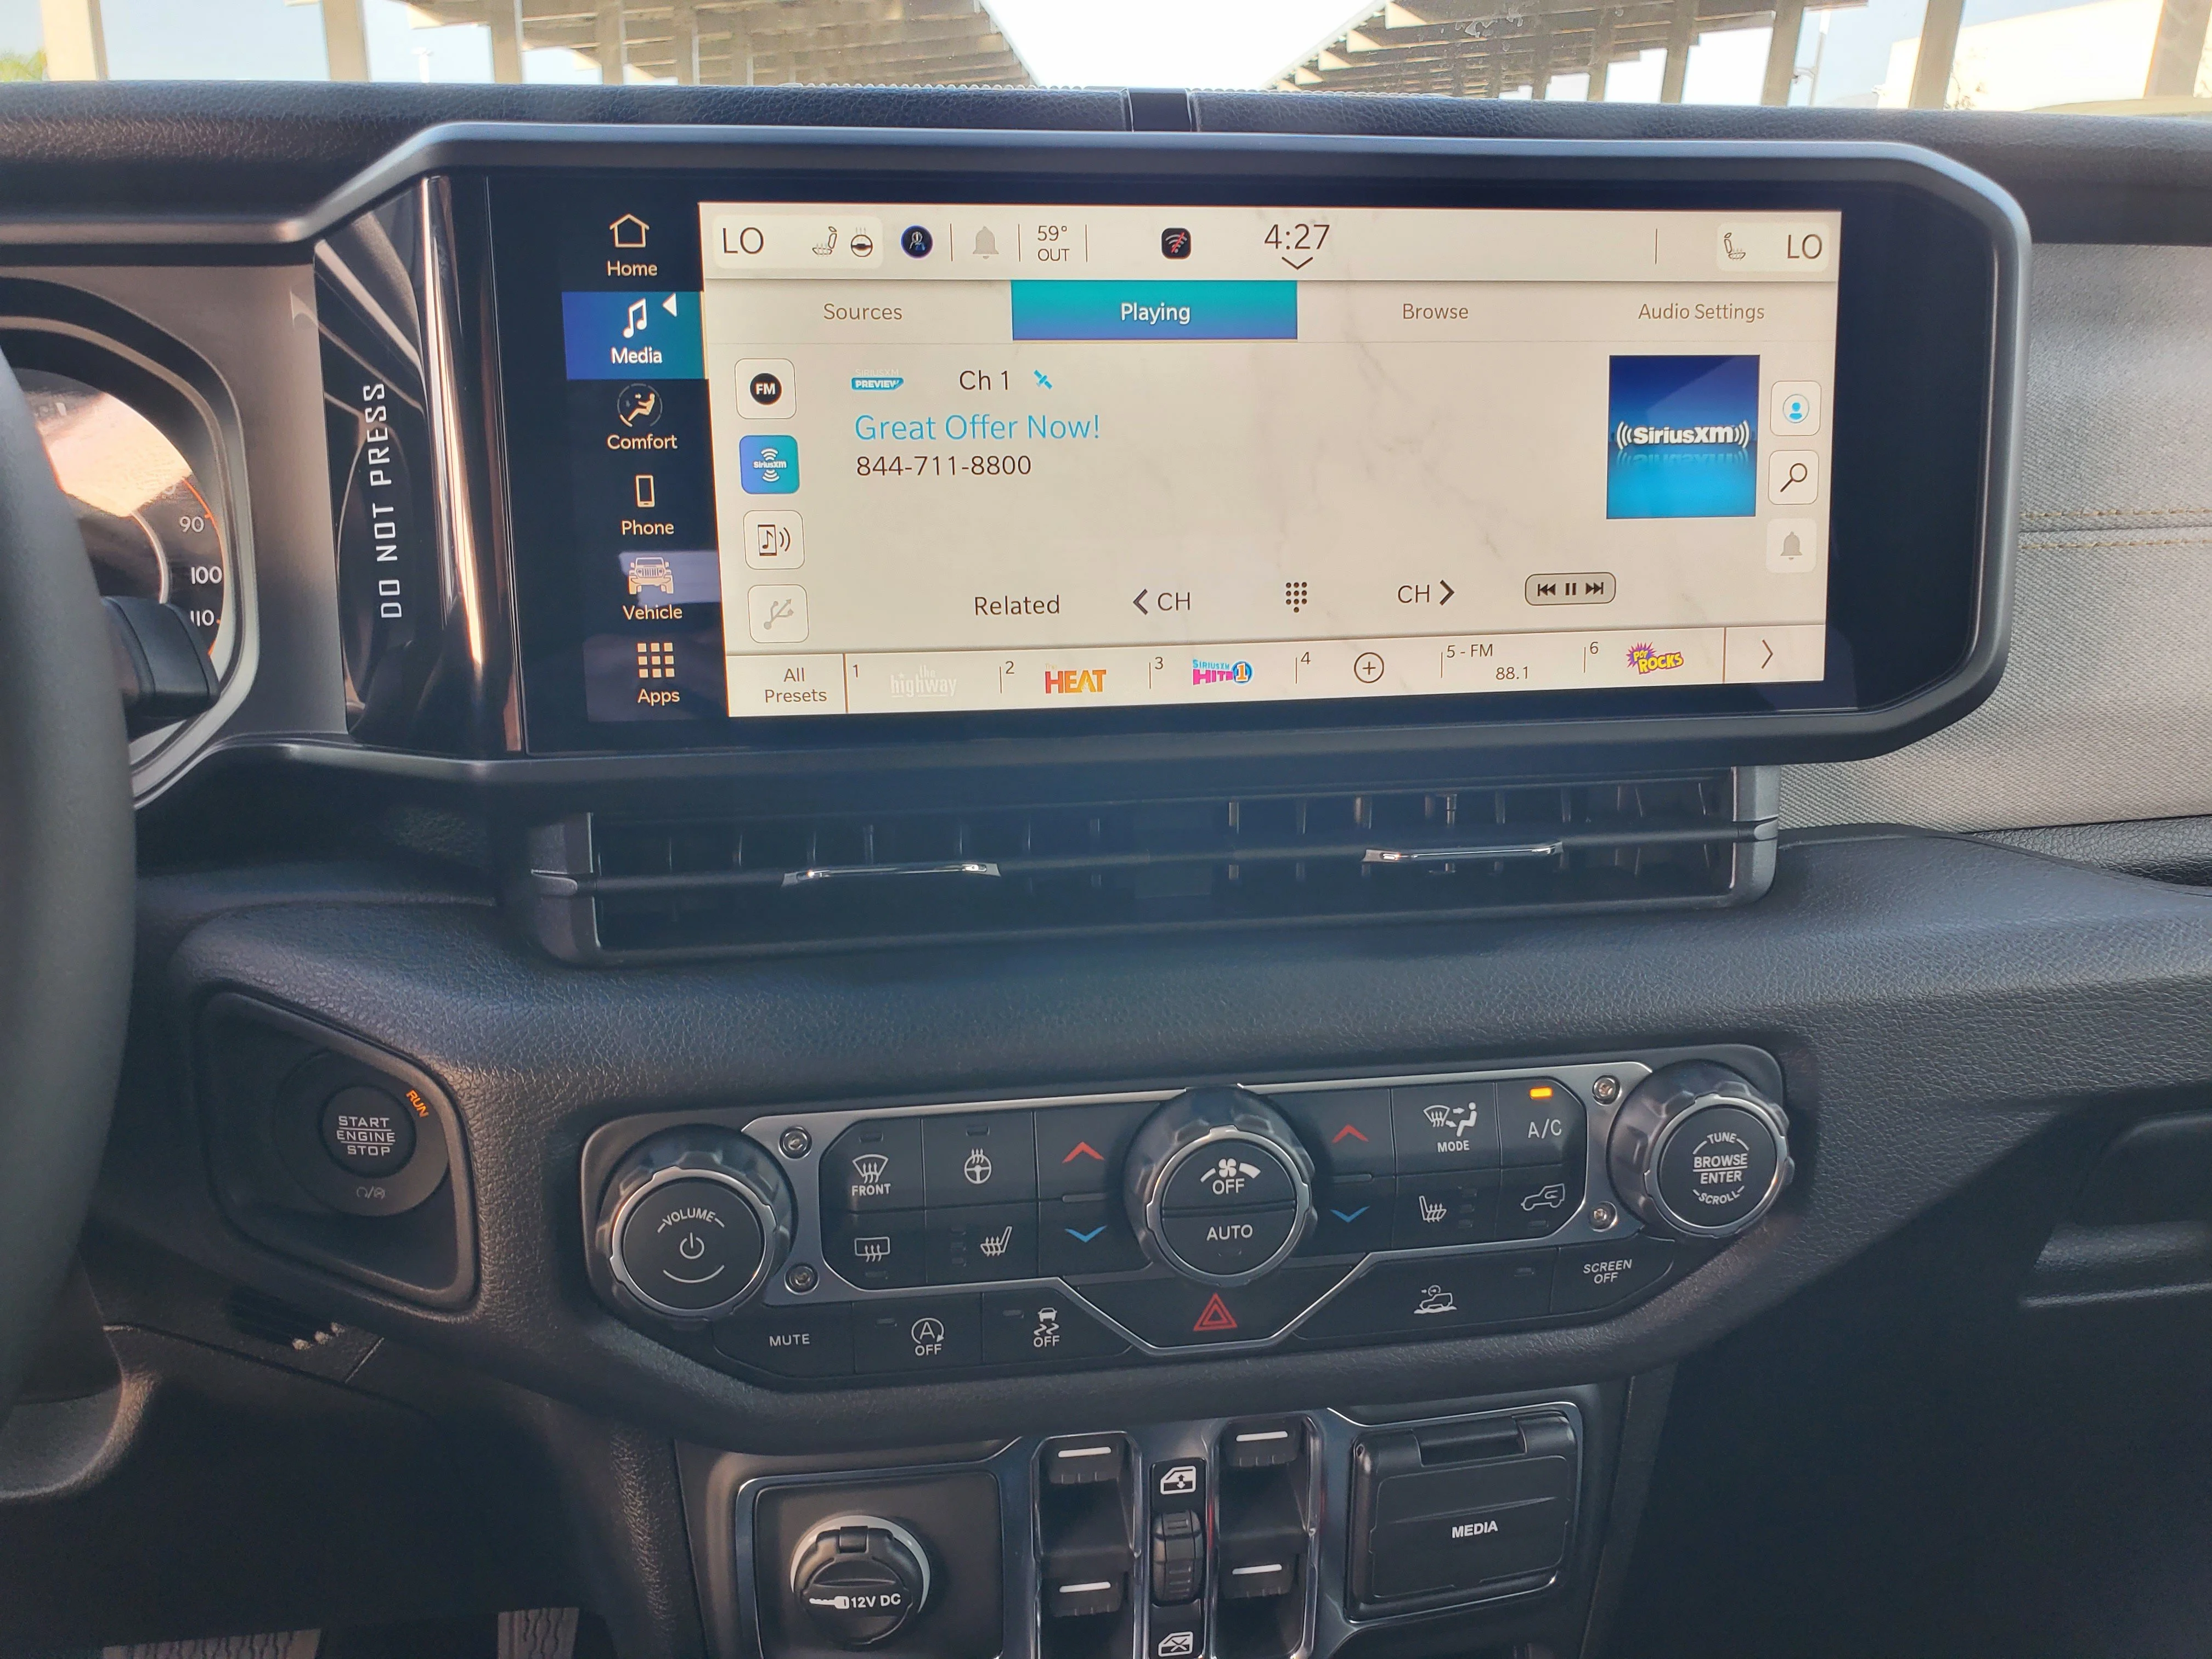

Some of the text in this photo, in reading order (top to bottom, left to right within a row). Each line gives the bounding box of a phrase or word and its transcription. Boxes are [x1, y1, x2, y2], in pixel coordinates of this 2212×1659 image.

[723, 227, 764, 255] LO
[1037, 225, 1068, 241] 59°
[1264, 223, 1330, 250] 4:27
[1787, 233, 1823, 259] LO
[1037, 249, 1070, 262] OUT
[607, 261, 658, 276] Home
[823, 303, 902, 321] Sources
[1120, 302, 1191, 325] Playing
[1402, 303, 1469, 319] Browse
[1638, 303, 1765, 323] Audio Settings
[611, 347, 663, 364] Media
[855, 380, 900, 388] PREVIEW
[959, 370, 1008, 391] Ch 1
[756, 383, 775, 396] FM
[855, 414, 1099, 440] Great Offer Now!
[607, 434, 678, 450] Comfort
[856, 455, 1031, 476] 844-711-8800
[363, 383, 402, 618] DO NOT PRESS
[179, 516, 205, 533] 90
[621, 520, 675, 535] Phone
[191, 566, 223, 584] 100
[1157, 591, 1191, 612] CH
[1397, 584, 1430, 604] CH
[623, 605, 683, 620] Vehicle
[974, 594, 1060, 616] Related
[190, 610, 215, 627] 110
[1447, 645, 1455, 658] 5
[1471, 644, 1493, 657] FM
[1590, 641, 1599, 654] 6
[1155, 657, 1163, 669] 3
[1300, 652, 1311, 664] 4
[1638, 653, 1683, 673] ROCKS
[783, 668, 805, 682] All
[853, 664, 859, 678] 1
[1005, 661, 1015, 674] 2
[1237, 663, 1248, 681] 1
[1496, 666, 1528, 680] 88.1
[890, 673, 957, 697] highway
[1045, 669, 1107, 694] HEAT
[637, 689, 680, 706] Apps
[765, 689, 827, 704] Presets
[406, 1090, 429, 1118] RUN
[338, 1115, 390, 1128] START
[1527, 1119, 1562, 1140] A/C
[336, 1130, 396, 1143] ENGINE
[1707, 1132, 1737, 1144] TUNE
[347, 1145, 391, 1156] STOP
[1437, 1139, 1470, 1153] MODE
[1694, 1153, 1748, 1168] BROWSE
[1701, 1171, 1742, 1184] ENTER
[851, 1183, 891, 1197] FRONT
[1212, 1178, 1245, 1195] OFF
[1699, 1191, 1740, 1205] SCROLL
[663, 1207, 715, 1227] VOLUME
[1206, 1224, 1253, 1241] AUTO
[1583, 1258, 1632, 1275] SCREEN
[1594, 1272, 1618, 1285] OFF
[769, 1333, 810, 1347] MUTE
[1033, 1335, 1060, 1348] OFF
[915, 1344, 942, 1357] OFF
[1452, 1520, 1498, 1538] MEDIA
[851, 1592, 901, 1608] 12V DC
